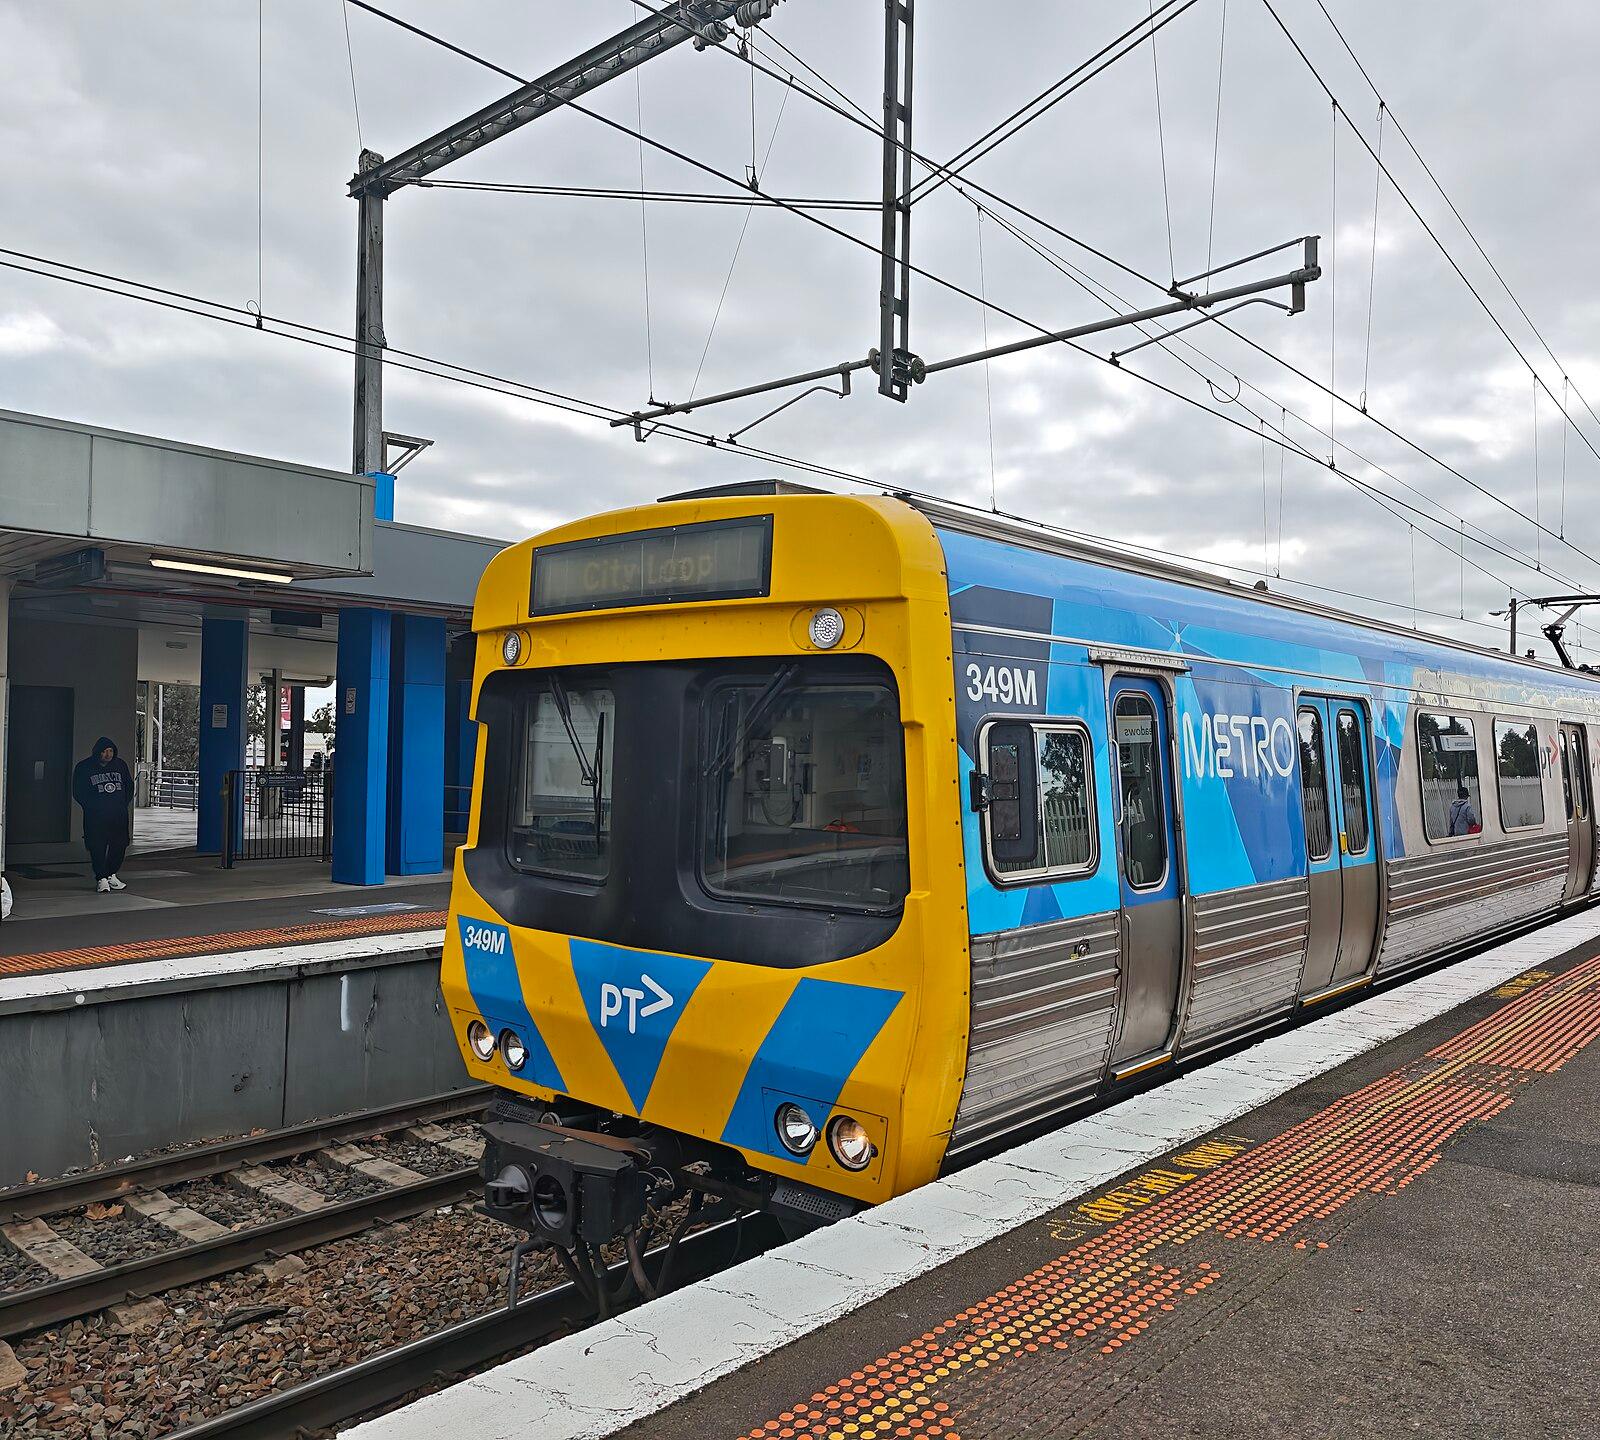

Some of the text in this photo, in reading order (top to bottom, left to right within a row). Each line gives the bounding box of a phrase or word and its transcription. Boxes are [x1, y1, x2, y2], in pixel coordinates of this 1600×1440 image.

[584, 553, 713, 592] City Loop
[966, 664, 1038, 706] 349M
[1182, 712, 1295, 779] METRO
[463, 925, 506, 955] 349M
